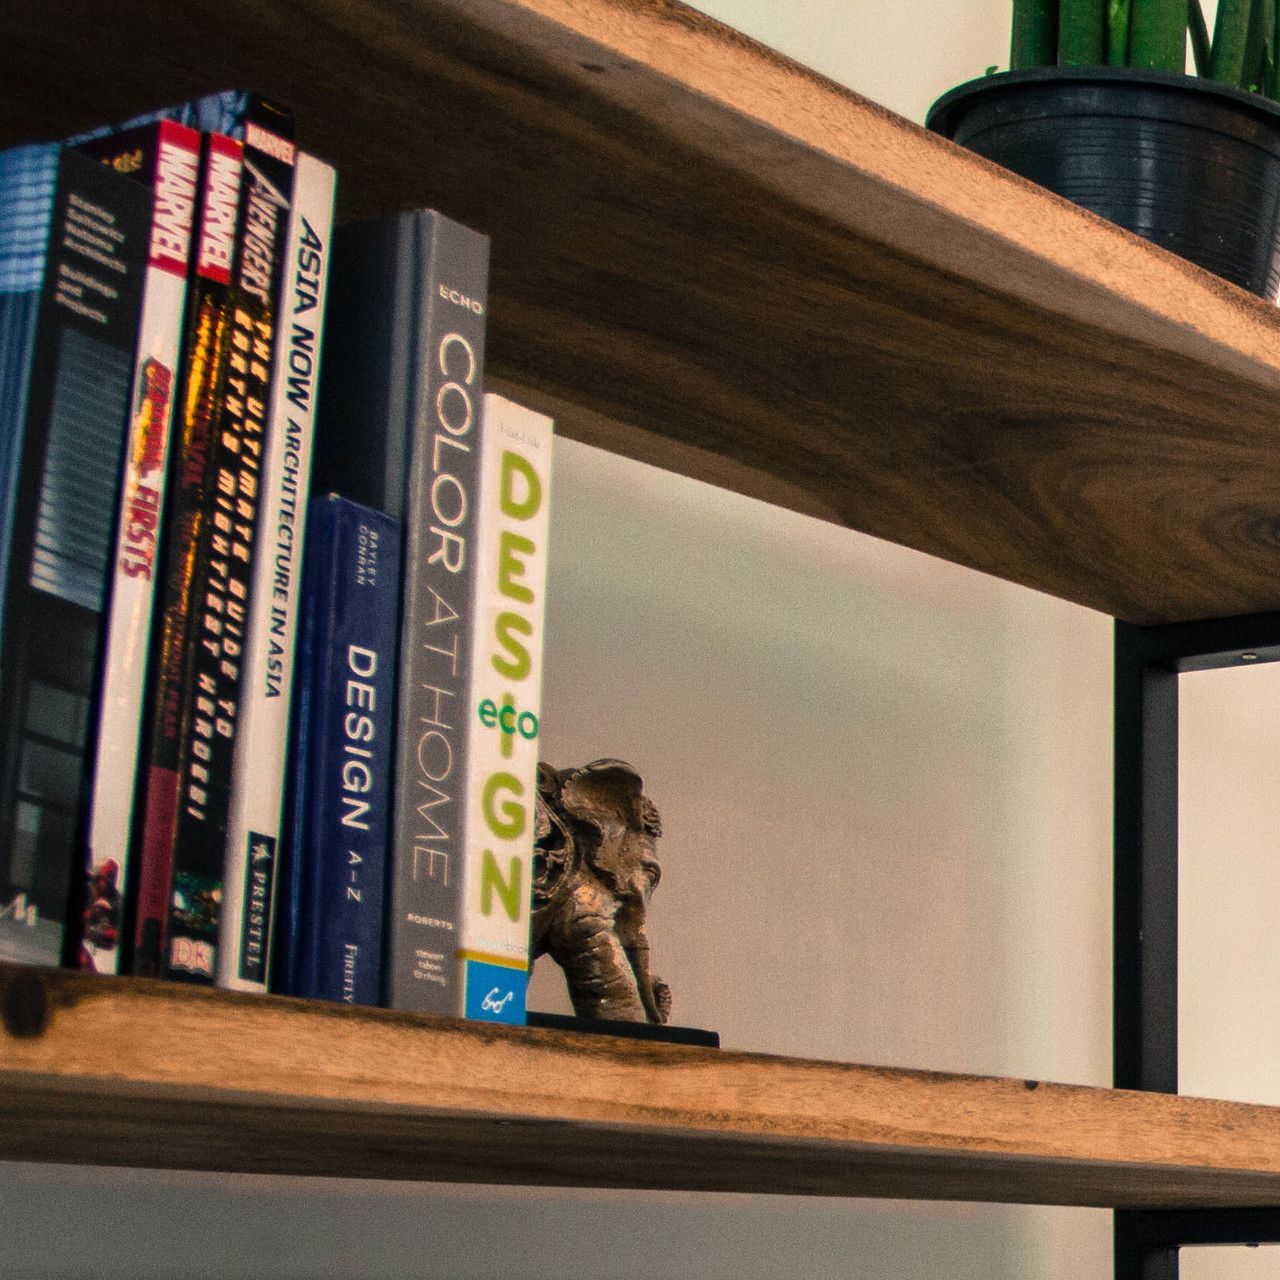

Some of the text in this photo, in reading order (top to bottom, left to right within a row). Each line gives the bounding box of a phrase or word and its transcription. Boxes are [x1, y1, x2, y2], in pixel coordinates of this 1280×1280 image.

[151, 141, 199, 267] MARVEL
[200, 150, 242, 277] MARVEL
[240, 158, 292, 305] AVENGERS
[439, 284, 485, 315] ECHO
[264, 216, 323, 698] ASIA NOW ARCHITECTURE IN ASIA
[122, 486, 160, 581] FIRSTS
[187, 309, 252, 821] EARTH'S MIGHTIEST HEROES!
[216, 320, 273, 739] THE ULTIMATE GUIDE TO
[356, 525, 368, 585] CONRAN
[364, 531, 379, 586] BAYLEY
[414, 333, 475, 887] COLOR AT HOME
[341, 645, 378, 830] DESIGN
[478, 698, 539, 740] eco
[247, 872, 268, 970] PRESTEL
